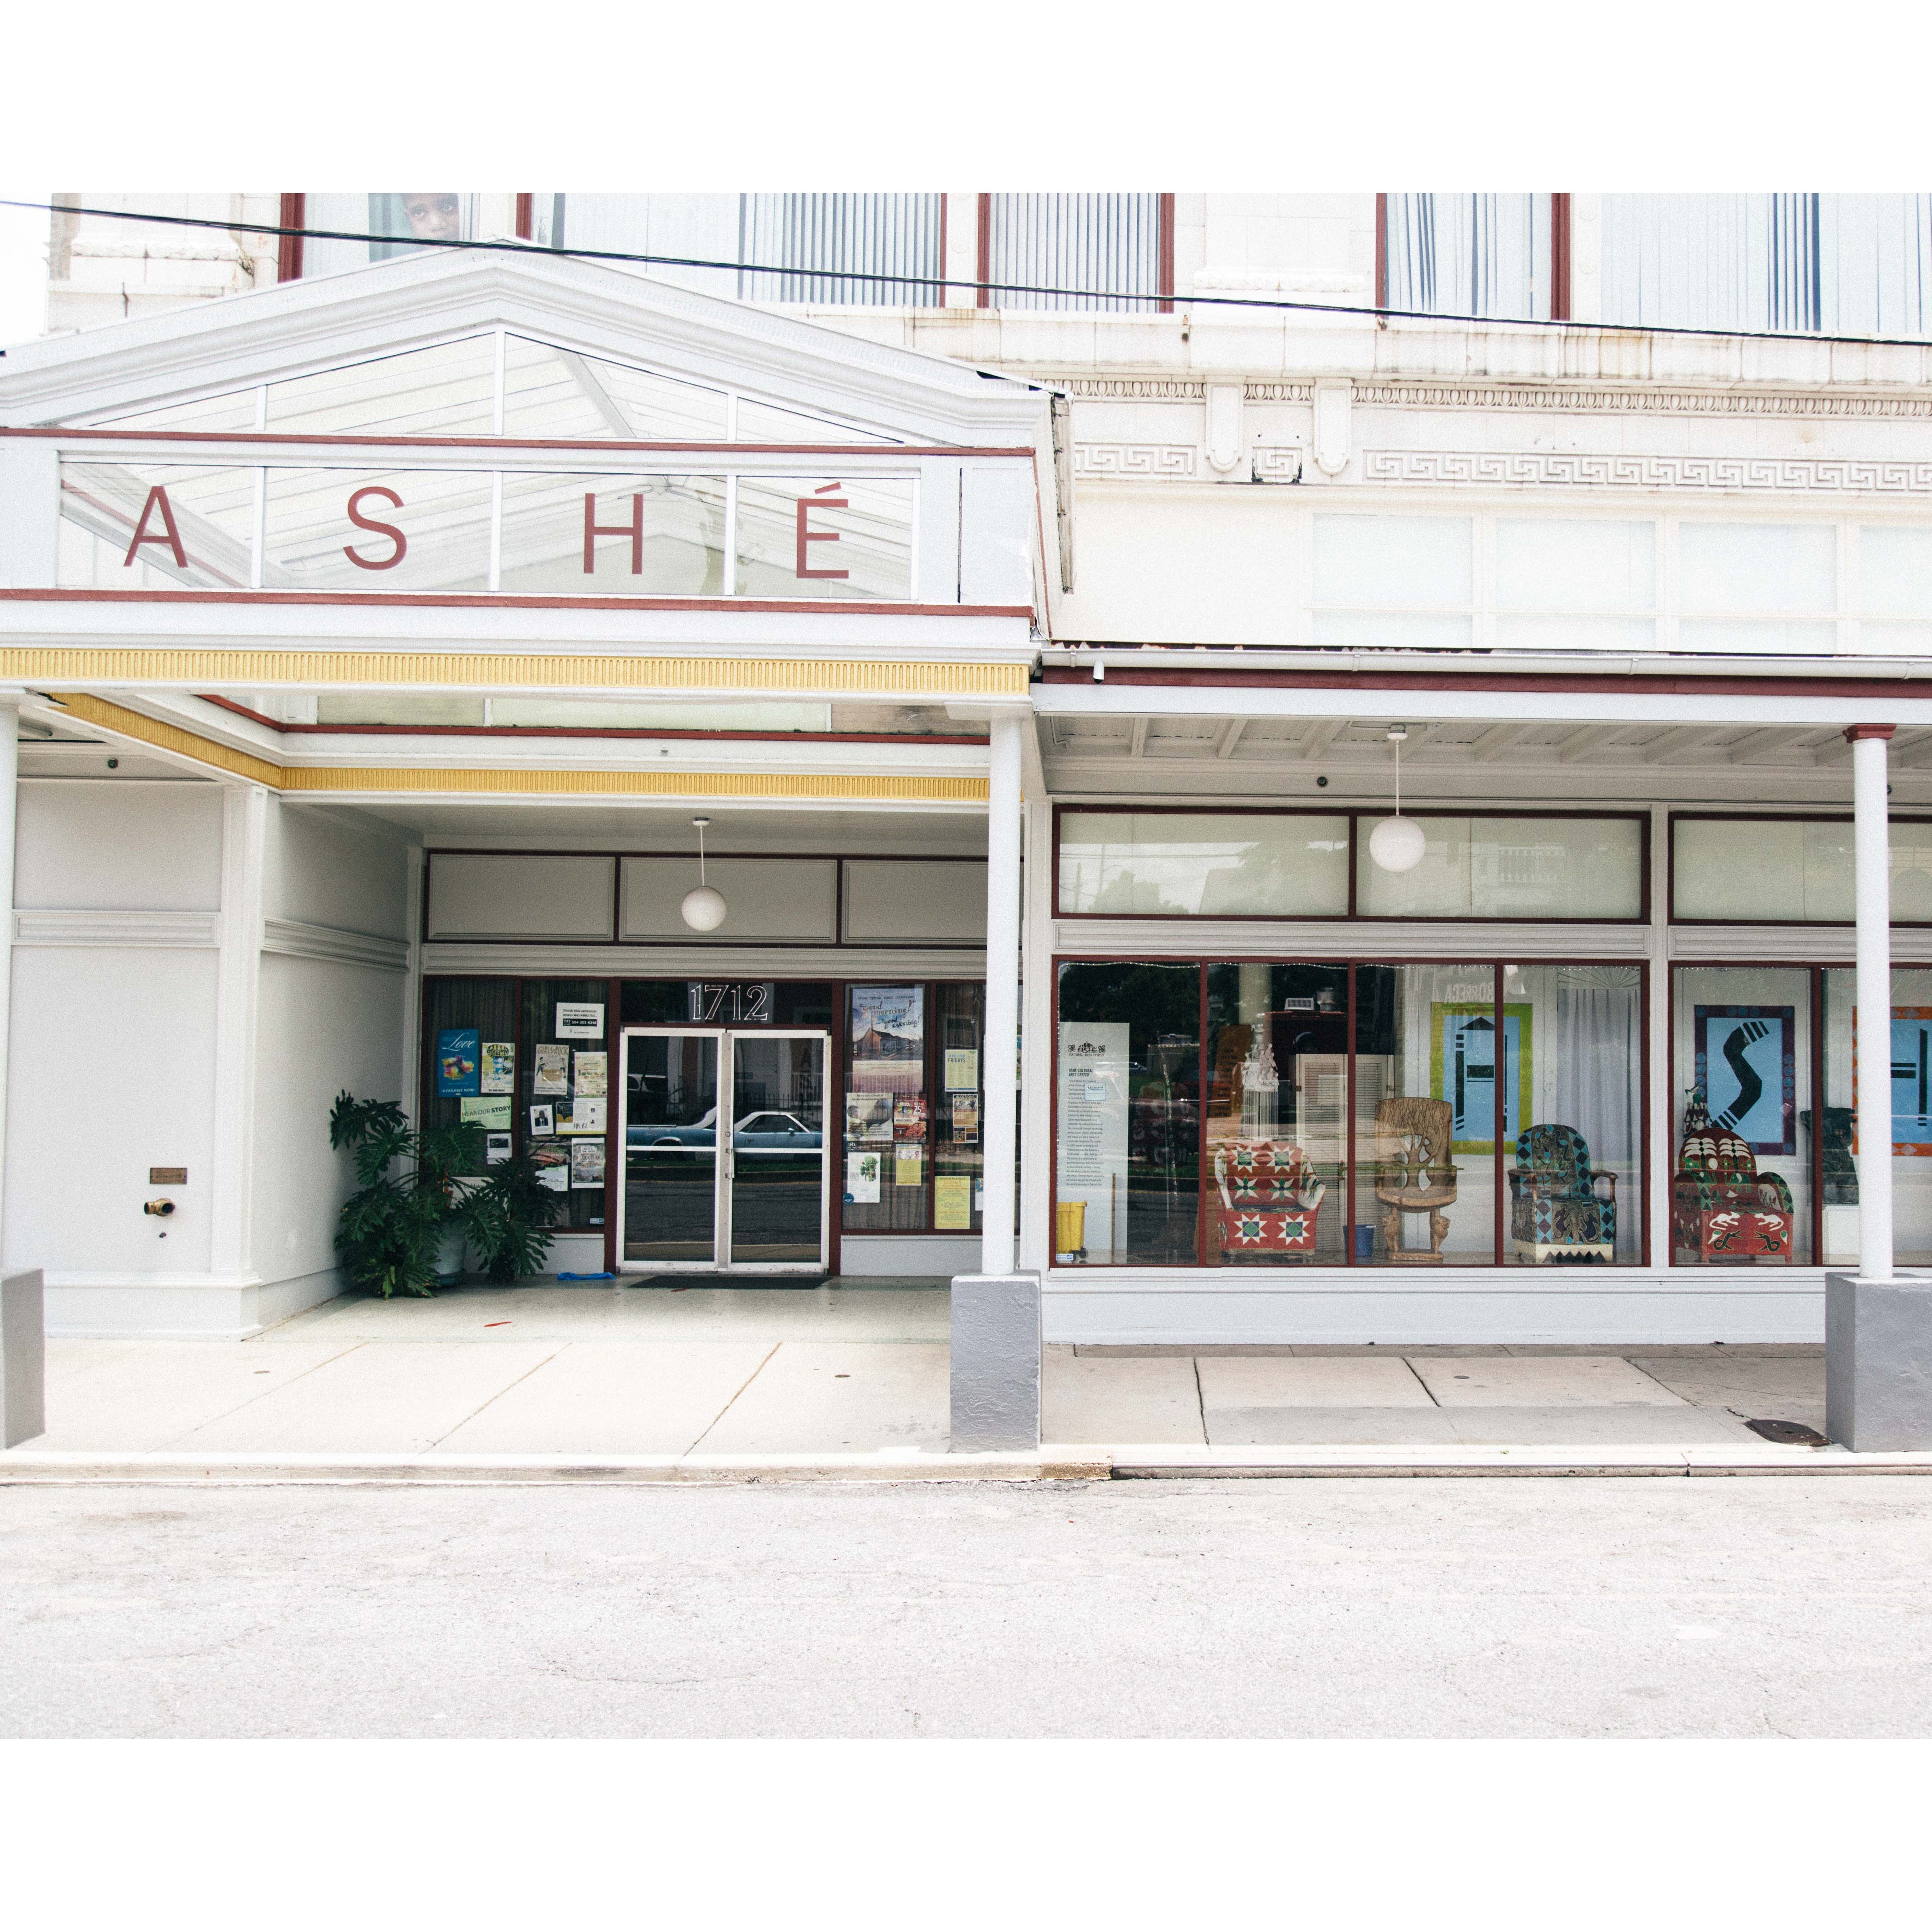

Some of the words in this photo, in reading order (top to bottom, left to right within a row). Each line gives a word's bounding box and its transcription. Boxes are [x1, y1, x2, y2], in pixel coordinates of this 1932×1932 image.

[125, 482, 849, 579] ASHÉ
[691, 985, 768, 1020] 1712
[442, 1033, 475, 1051] Love
[538, 1046, 552, 1055] GIRLS
[555, 1046, 568, 1055] ROCK
